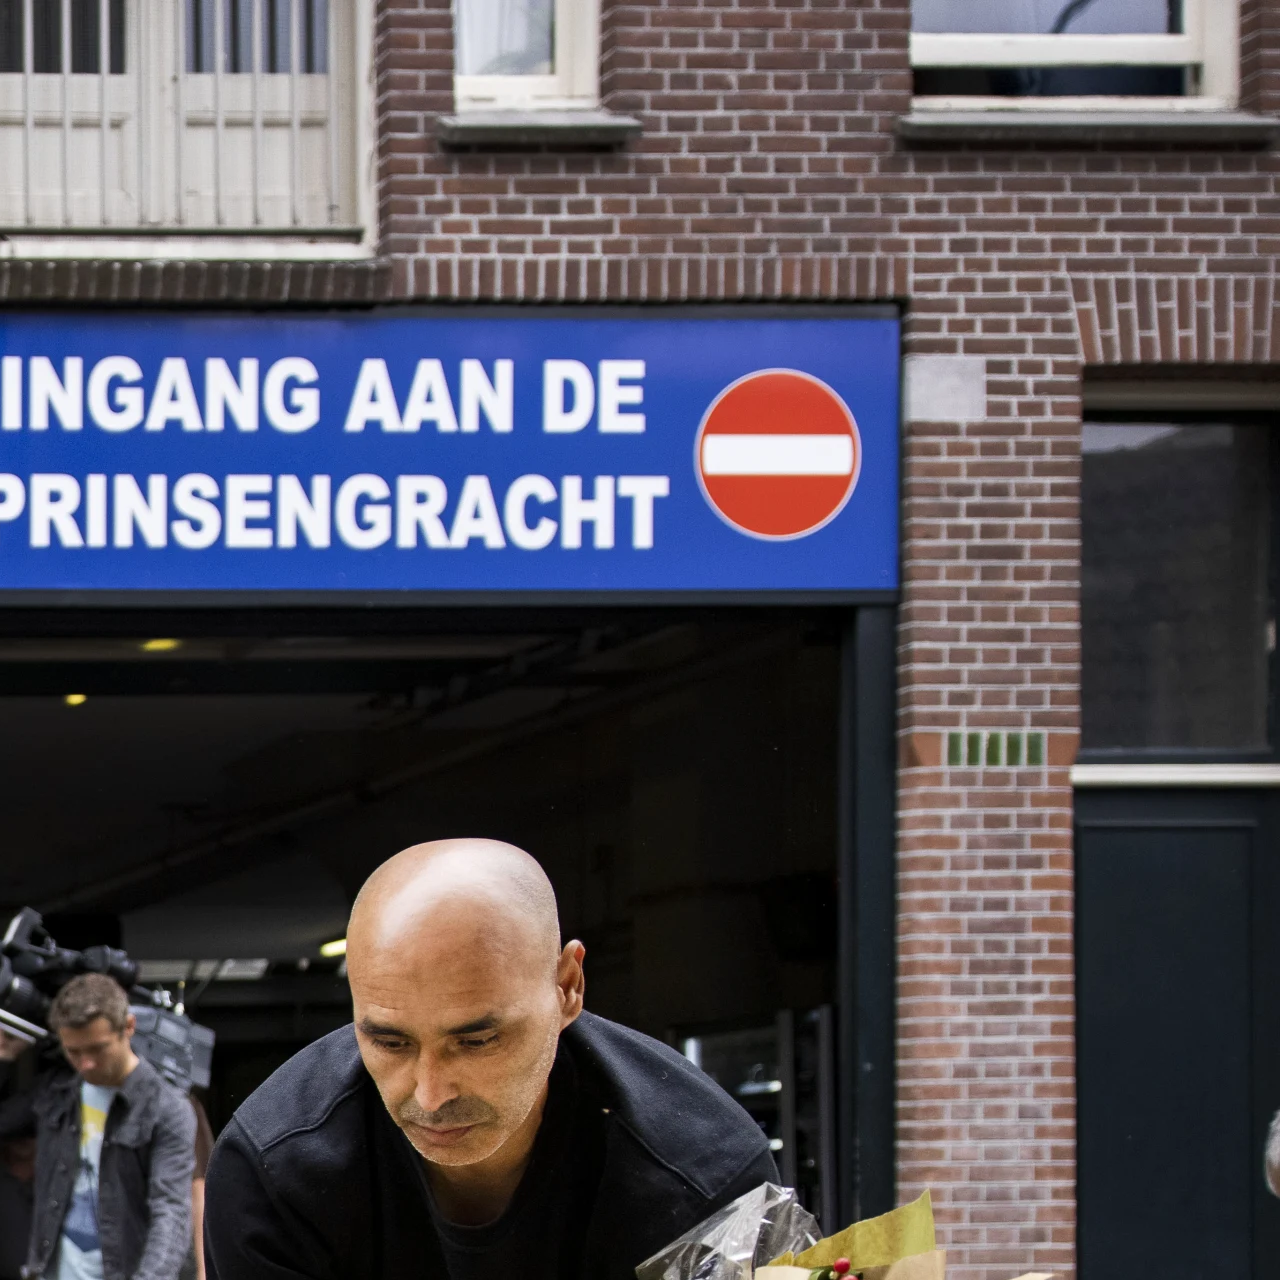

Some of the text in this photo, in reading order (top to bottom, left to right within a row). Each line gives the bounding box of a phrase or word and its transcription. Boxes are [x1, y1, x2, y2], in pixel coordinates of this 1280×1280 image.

[1, 355, 646, 433] INGANG AAN DE
